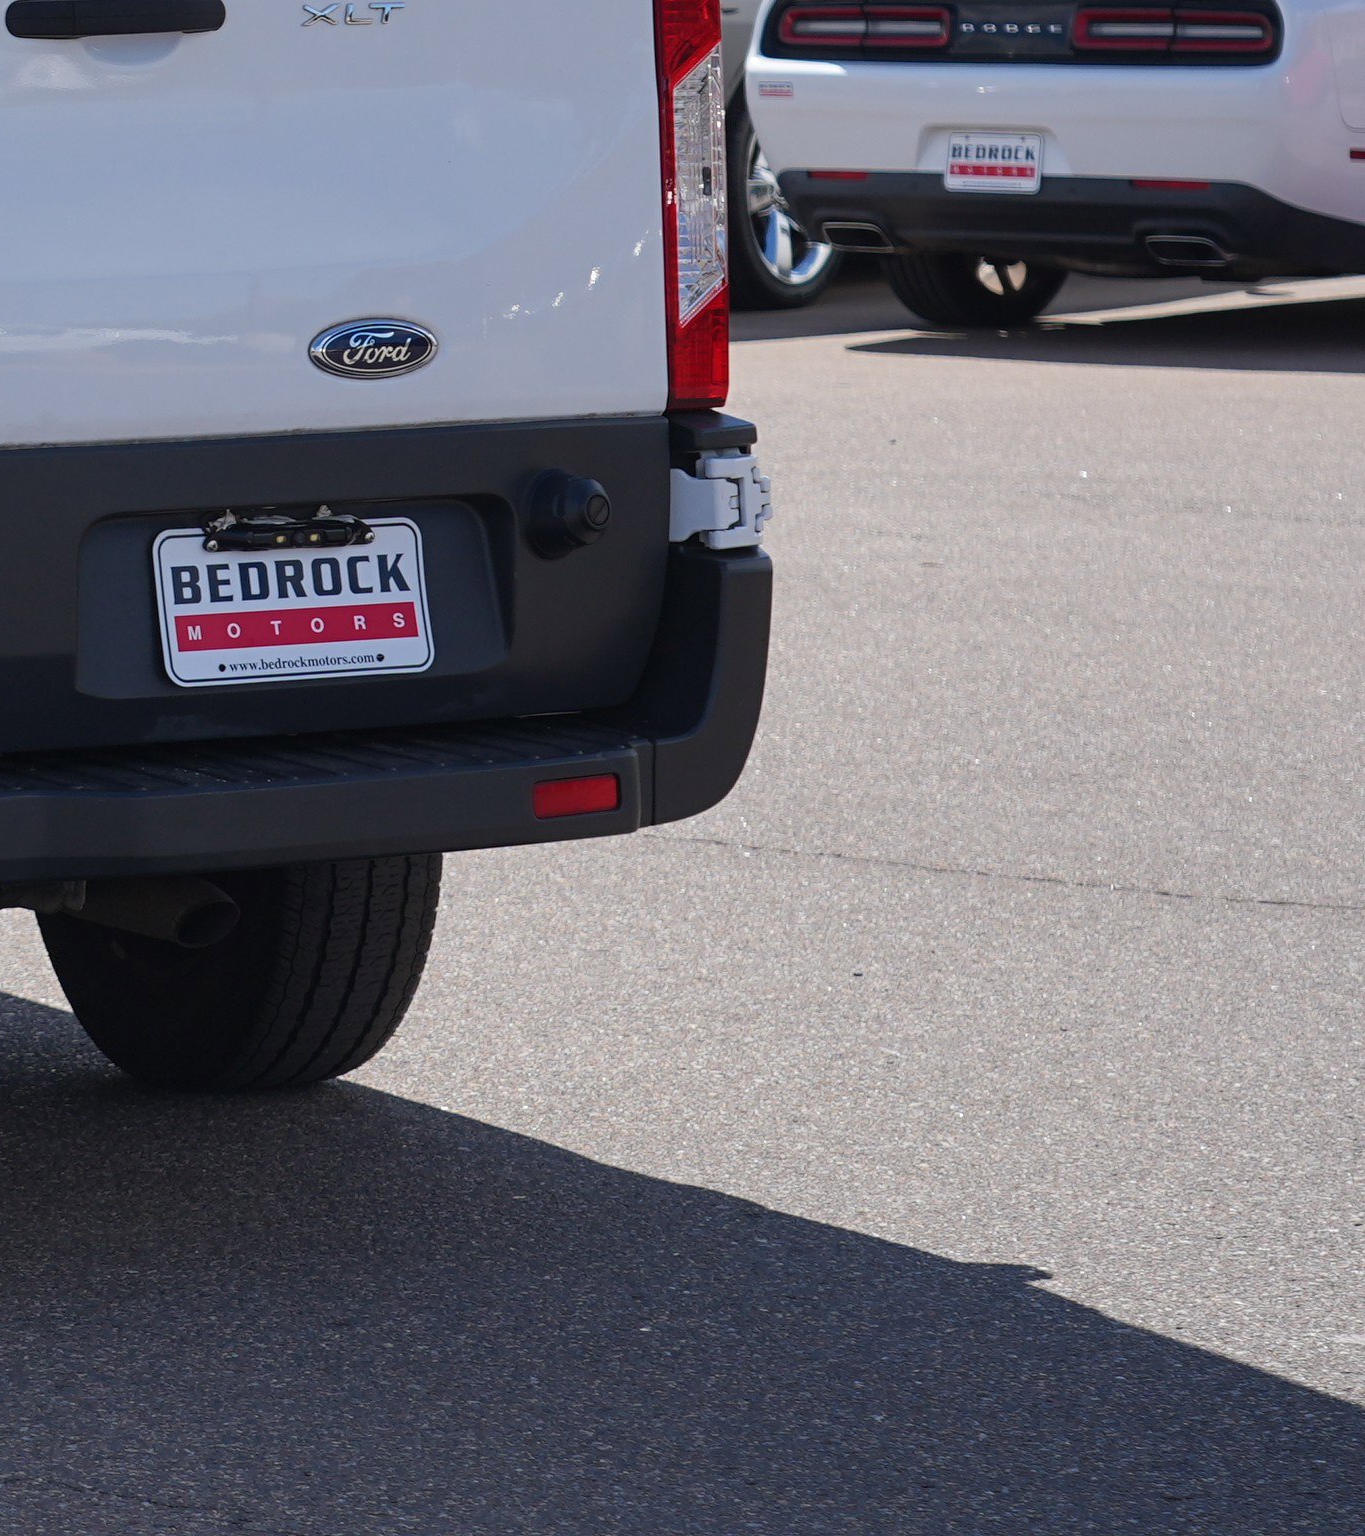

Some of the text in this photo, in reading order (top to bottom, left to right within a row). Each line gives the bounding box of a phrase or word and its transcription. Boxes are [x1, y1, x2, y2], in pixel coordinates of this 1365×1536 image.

[300, 1, 406, 27] XLT
[951, 143, 1036, 161] BEDROCK
[342, 331, 412, 365] Ford
[170, 553, 411, 605] BEDROCK
[187, 612, 406, 641] MOTORS
[229, 652, 375, 672] www.bedrockmotors.com
